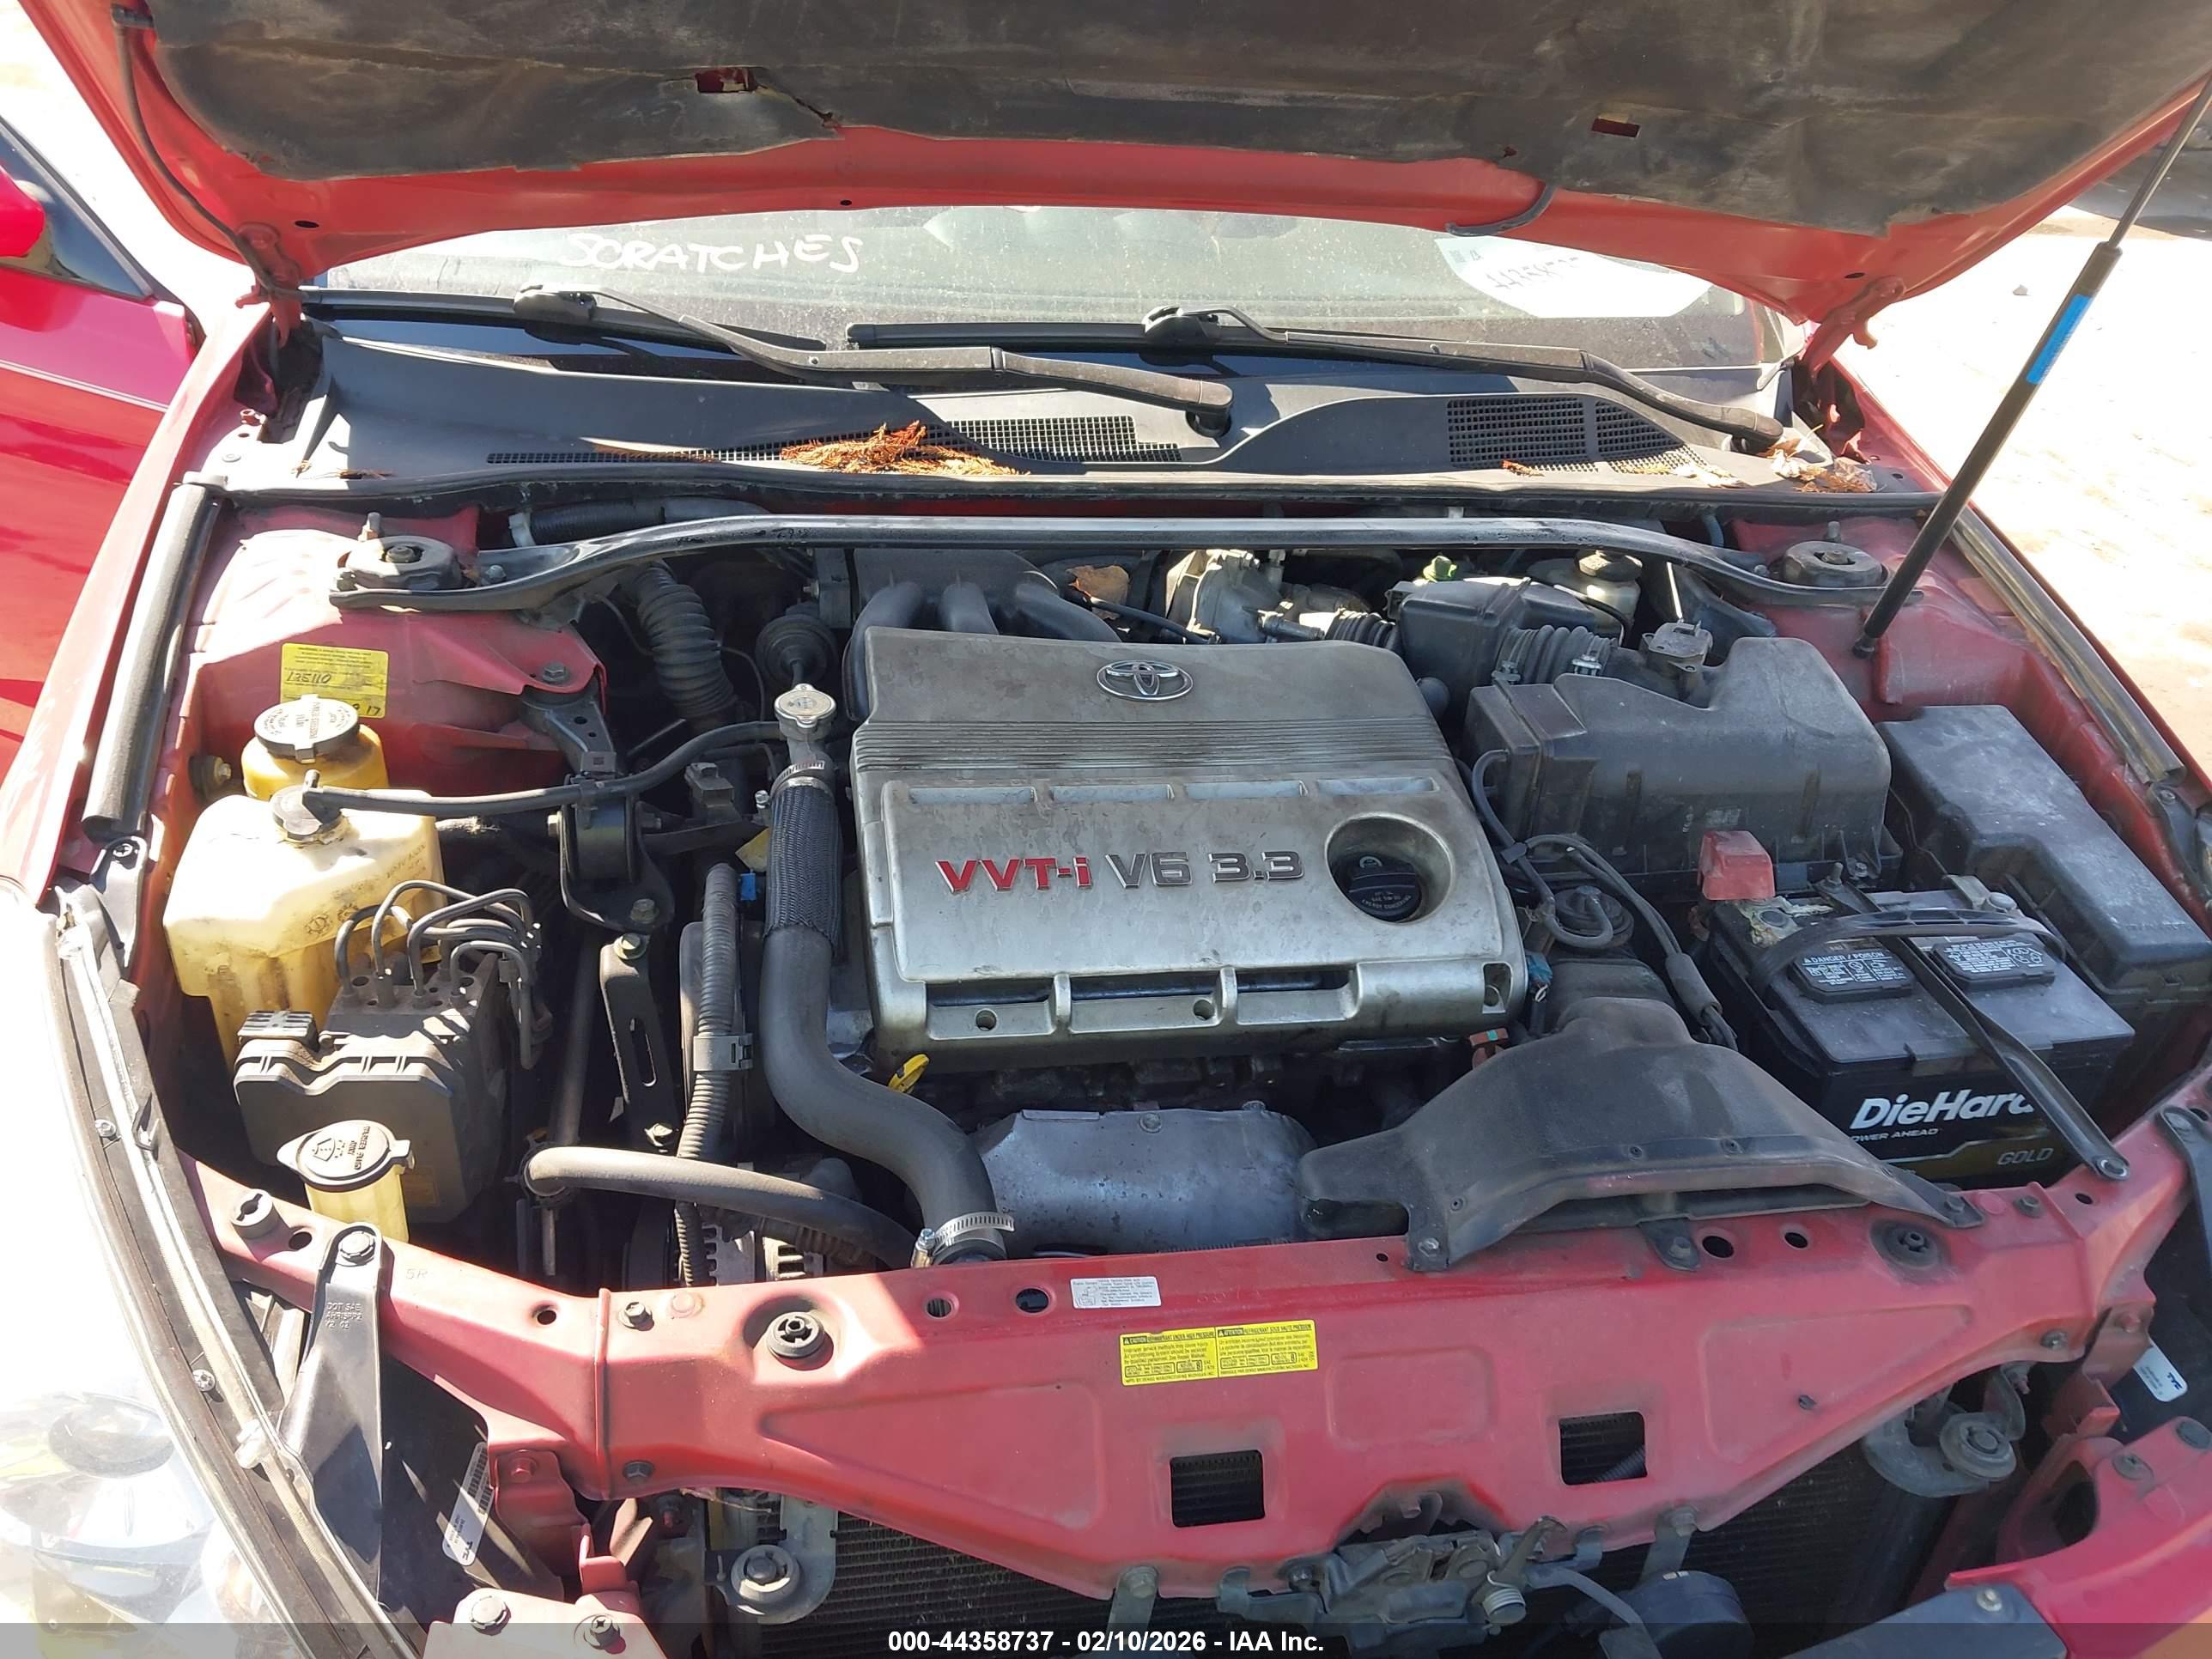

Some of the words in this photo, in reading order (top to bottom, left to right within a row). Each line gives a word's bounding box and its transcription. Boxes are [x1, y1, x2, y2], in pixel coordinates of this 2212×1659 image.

[935, 856, 1093, 894] VVT-i
[1105, 852, 1194, 889] V6
[1208, 851, 1305, 884] 3.3
[1850, 1133, 1890, 1143] OWER
[1891, 1128, 1939, 1139] AHEAD
[1996, 1148, 2054, 1165] GOLD
[327, 1302, 343, 1310] DOT
